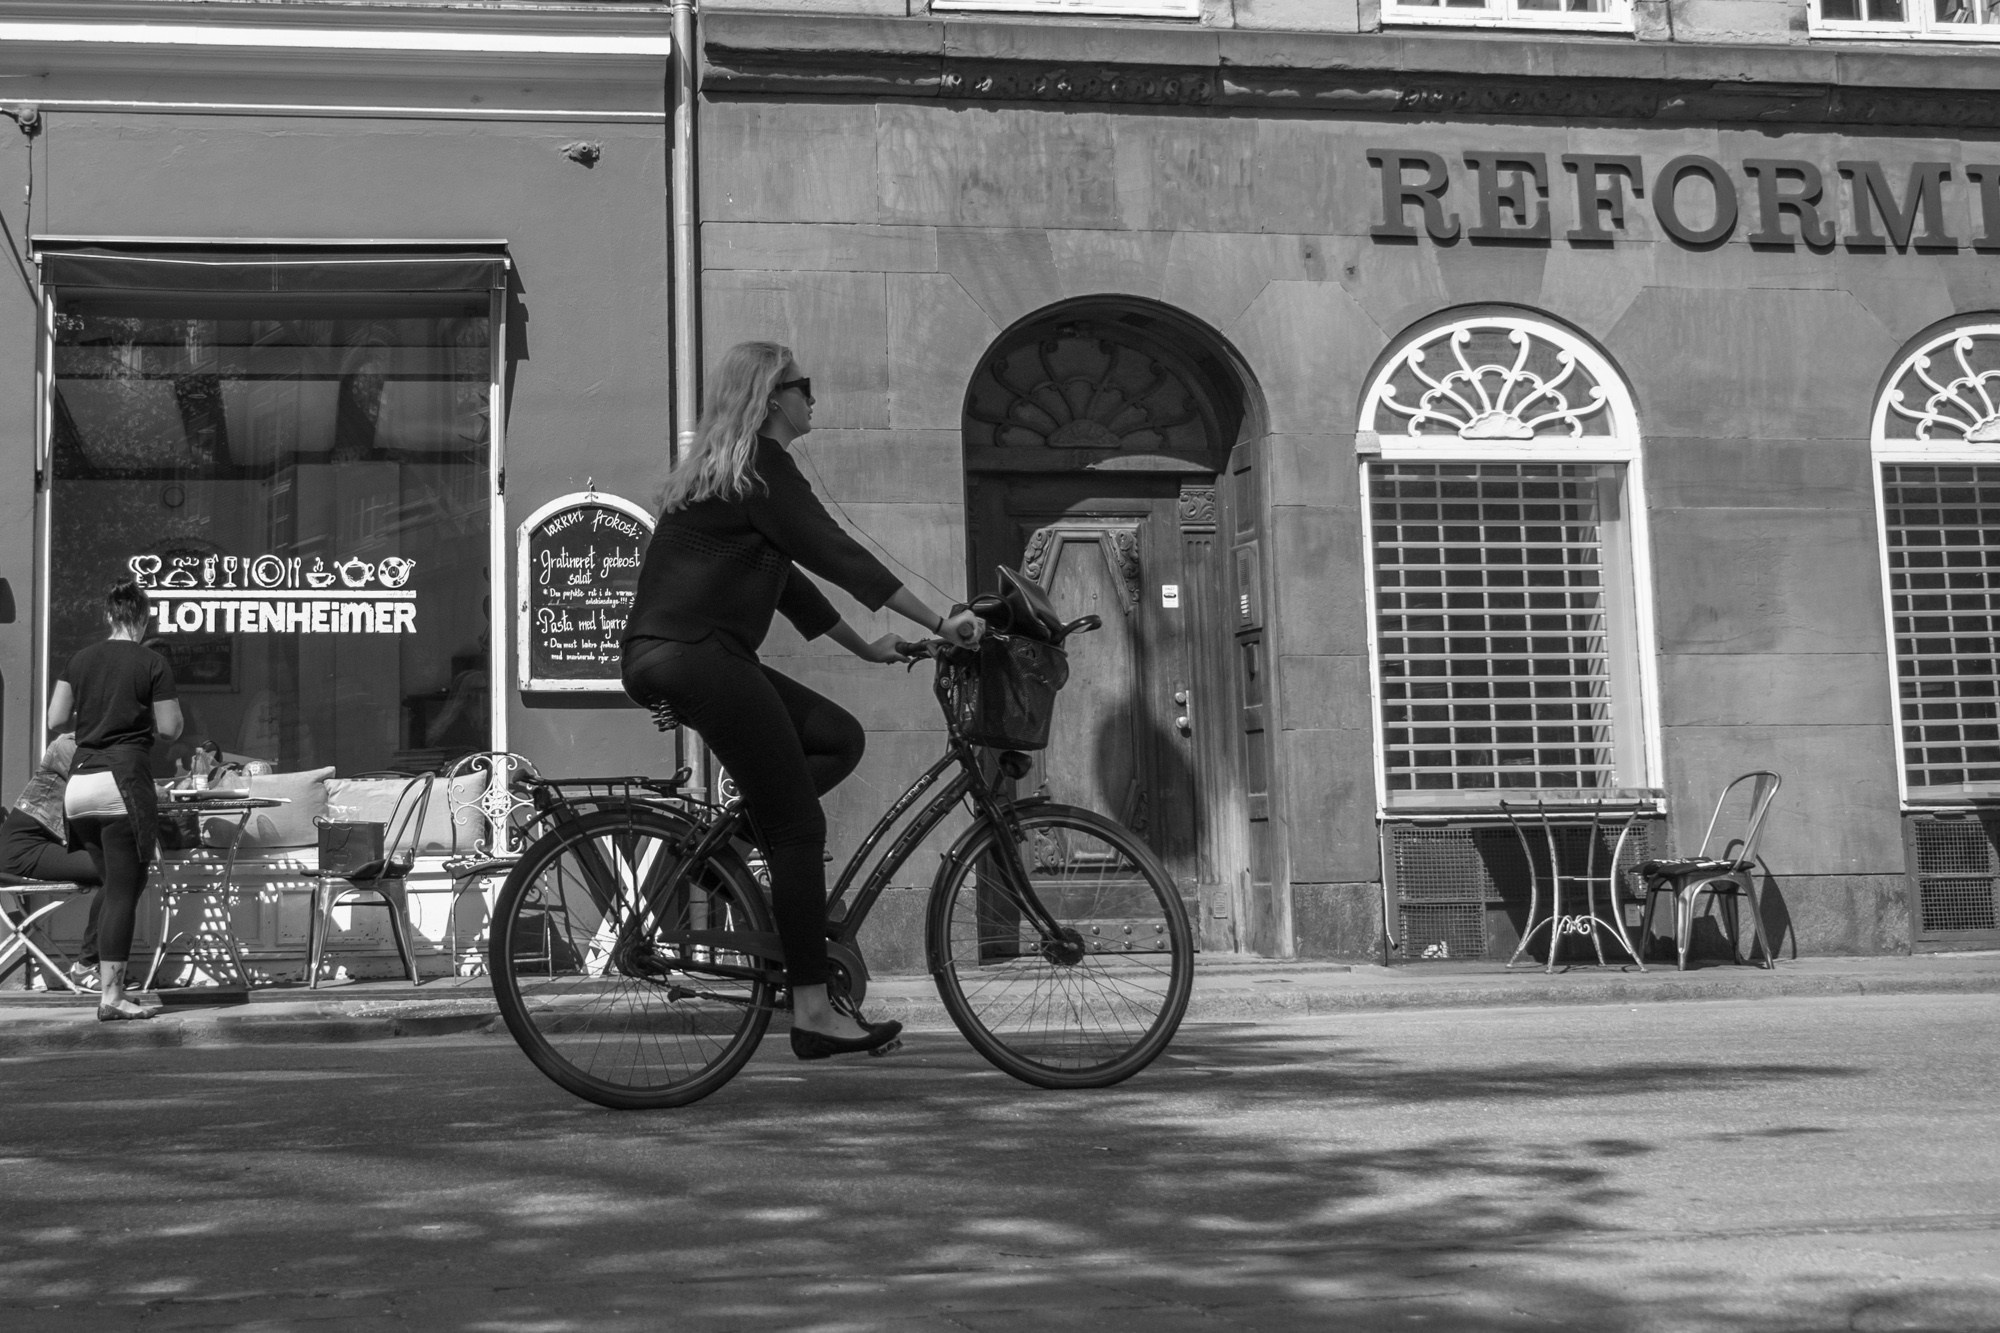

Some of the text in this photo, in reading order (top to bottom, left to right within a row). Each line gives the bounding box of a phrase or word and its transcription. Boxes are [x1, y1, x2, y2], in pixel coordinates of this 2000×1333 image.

[567, 569, 592, 585] salat
[600, 546, 640, 578] gedeost
[538, 607, 629, 639] Pasta med tigerre
